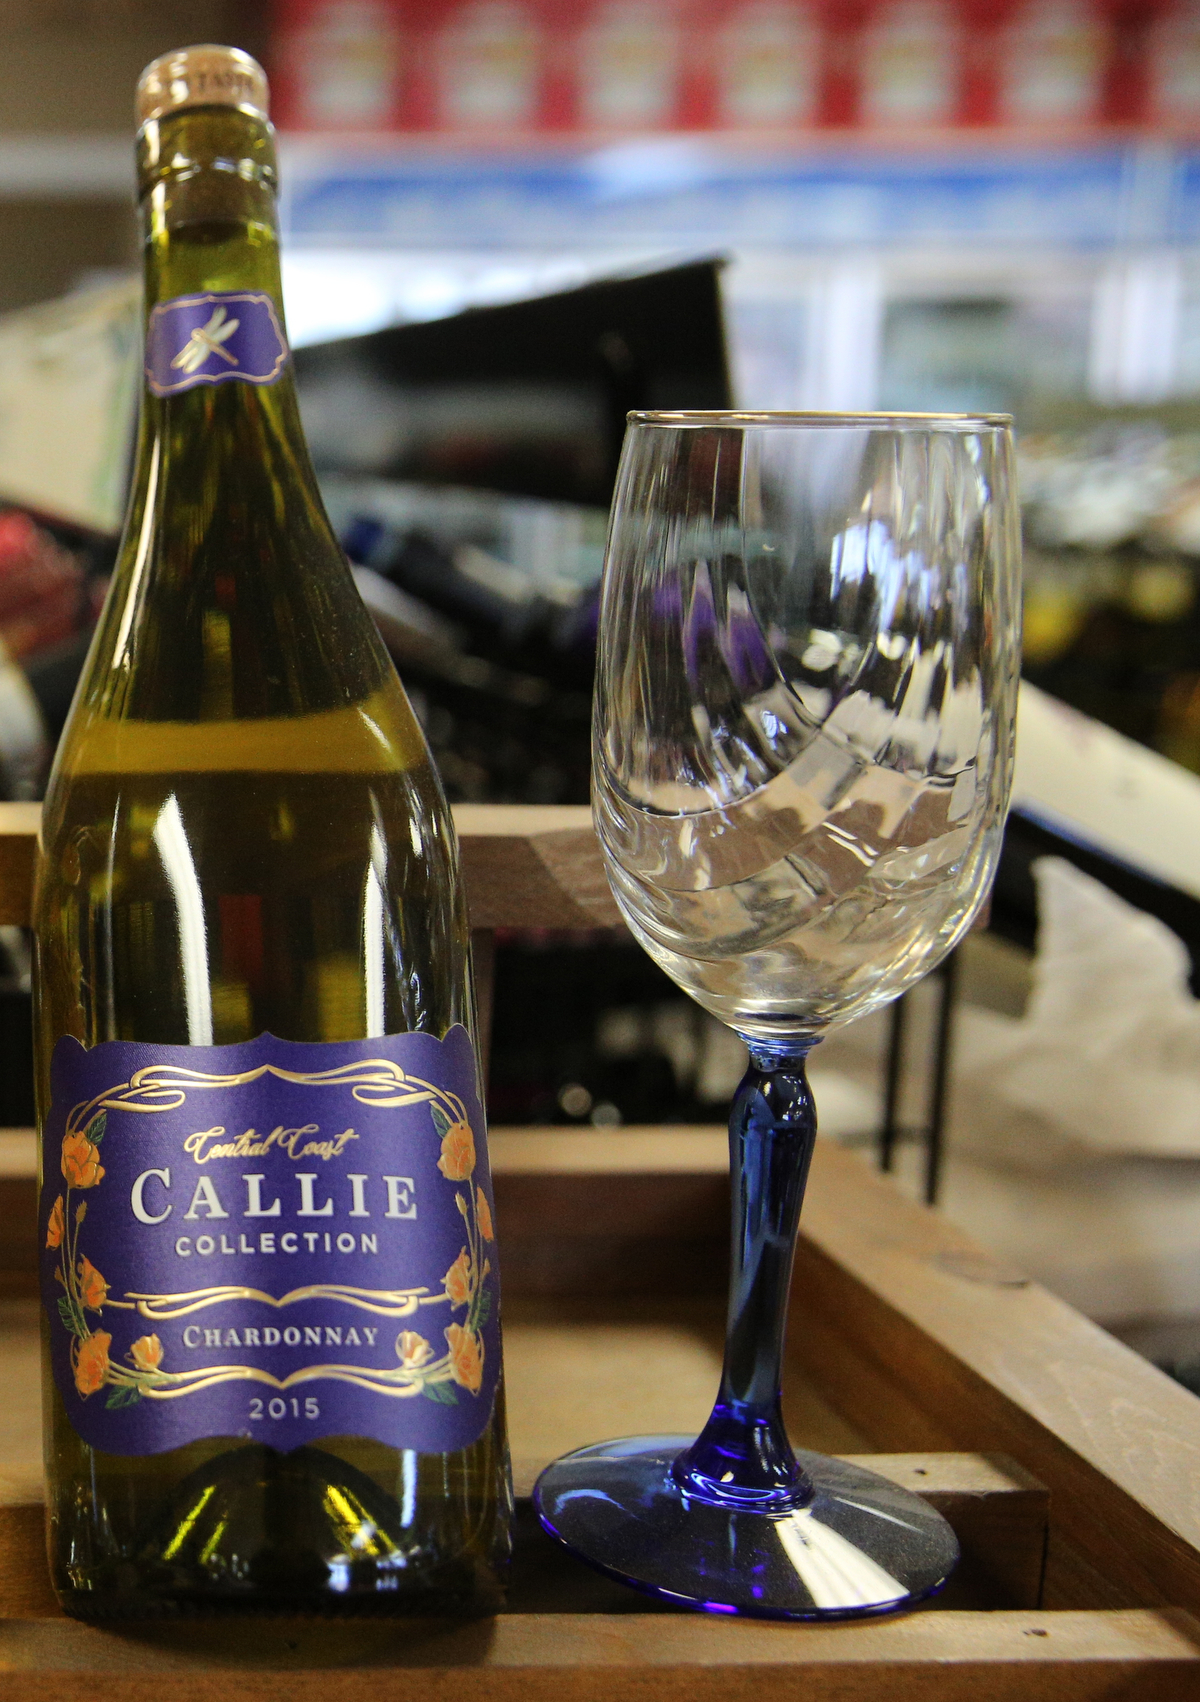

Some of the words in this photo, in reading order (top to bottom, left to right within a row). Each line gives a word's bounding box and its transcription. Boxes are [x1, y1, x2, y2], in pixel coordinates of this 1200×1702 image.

[183, 1125, 284, 1165] Central
[277, 1123, 360, 1161] Coast
[130, 1166, 419, 1225] CALLIE
[174, 1231, 380, 1258] COLLECTION
[181, 1325, 380, 1350] CHARDONNAY
[248, 1396, 321, 1421] 2015
